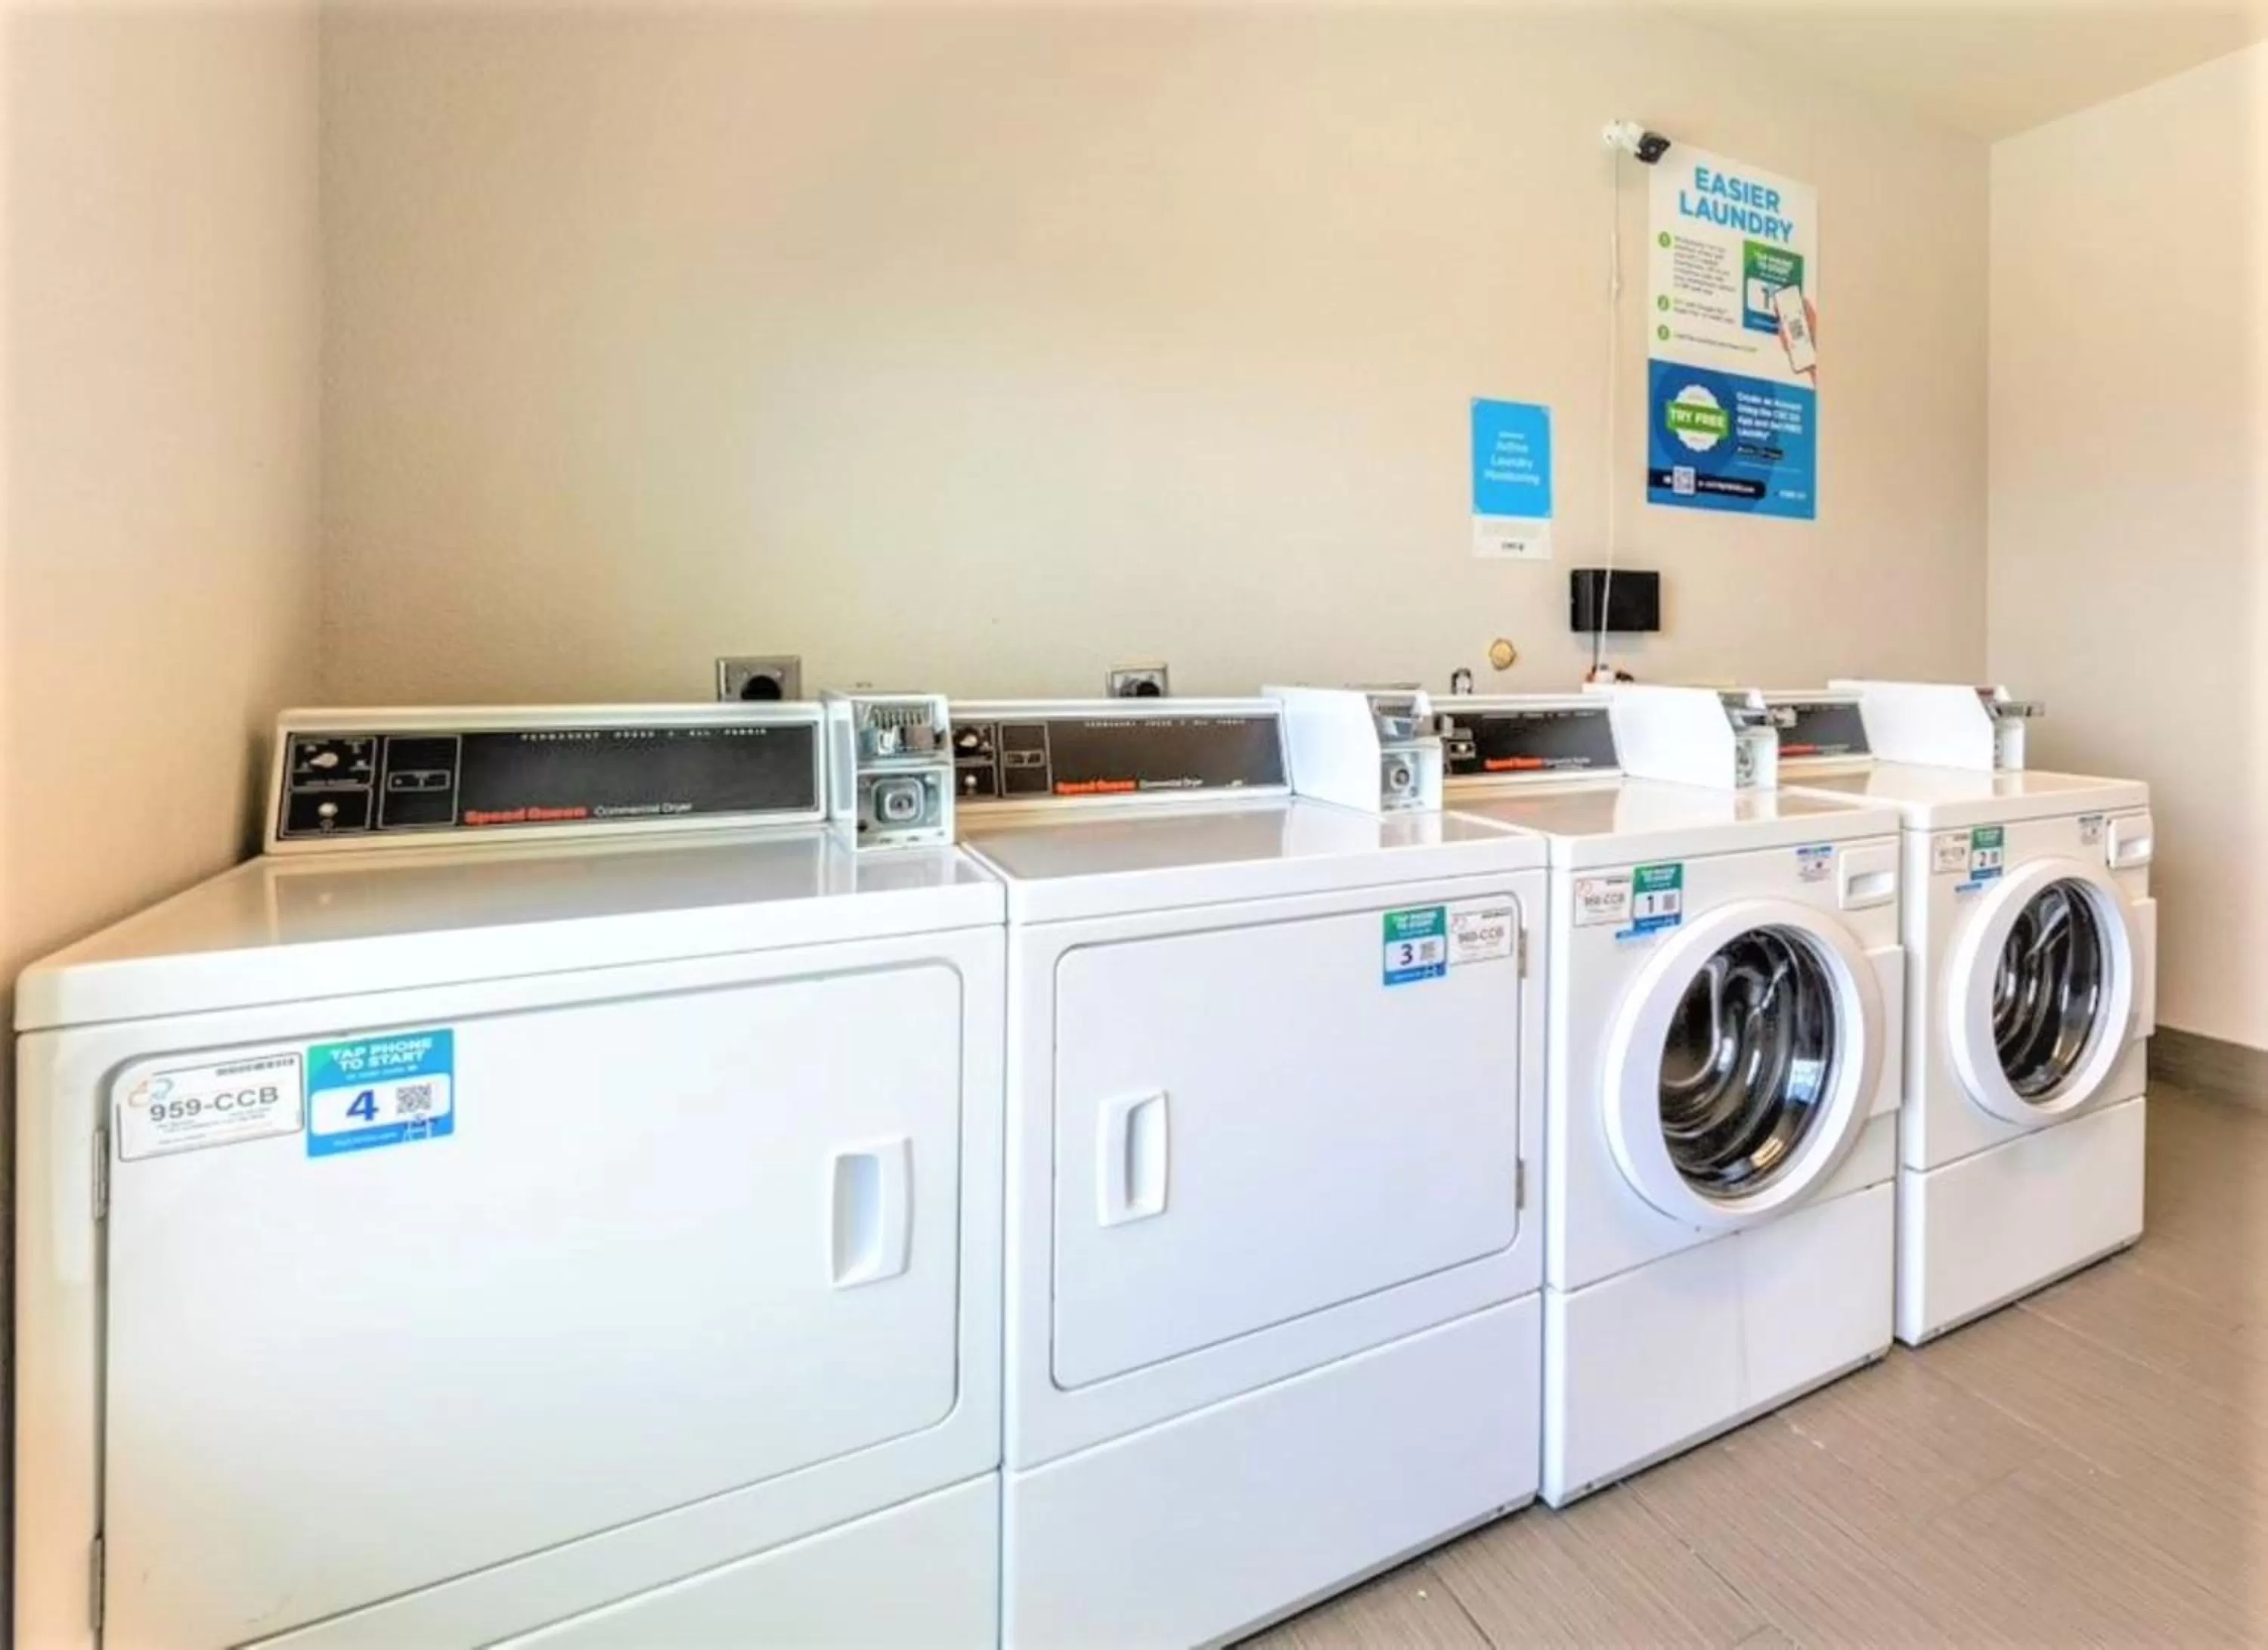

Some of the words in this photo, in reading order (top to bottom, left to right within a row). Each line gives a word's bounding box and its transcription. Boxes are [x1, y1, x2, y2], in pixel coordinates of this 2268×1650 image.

[1694, 166, 1780, 213] EASIER
[1679, 190, 1793, 243] LAUNDRY
[1669, 406, 1693, 423] TRY
[1695, 412, 1725, 429] FREE
[464, 808, 526, 825] Speed
[528, 805, 587, 820] Queen
[1647, 894, 1655, 913] 1
[1400, 943, 1414, 966] 3
[330, 1046, 367, 1062] TAP
[369, 1037, 433, 1055] PHONE
[340, 1058, 364, 1072] TO
[367, 1050, 426, 1068] START
[150, 1086, 279, 1122] 959-CCB
[345, 1088, 380, 1121] 4
